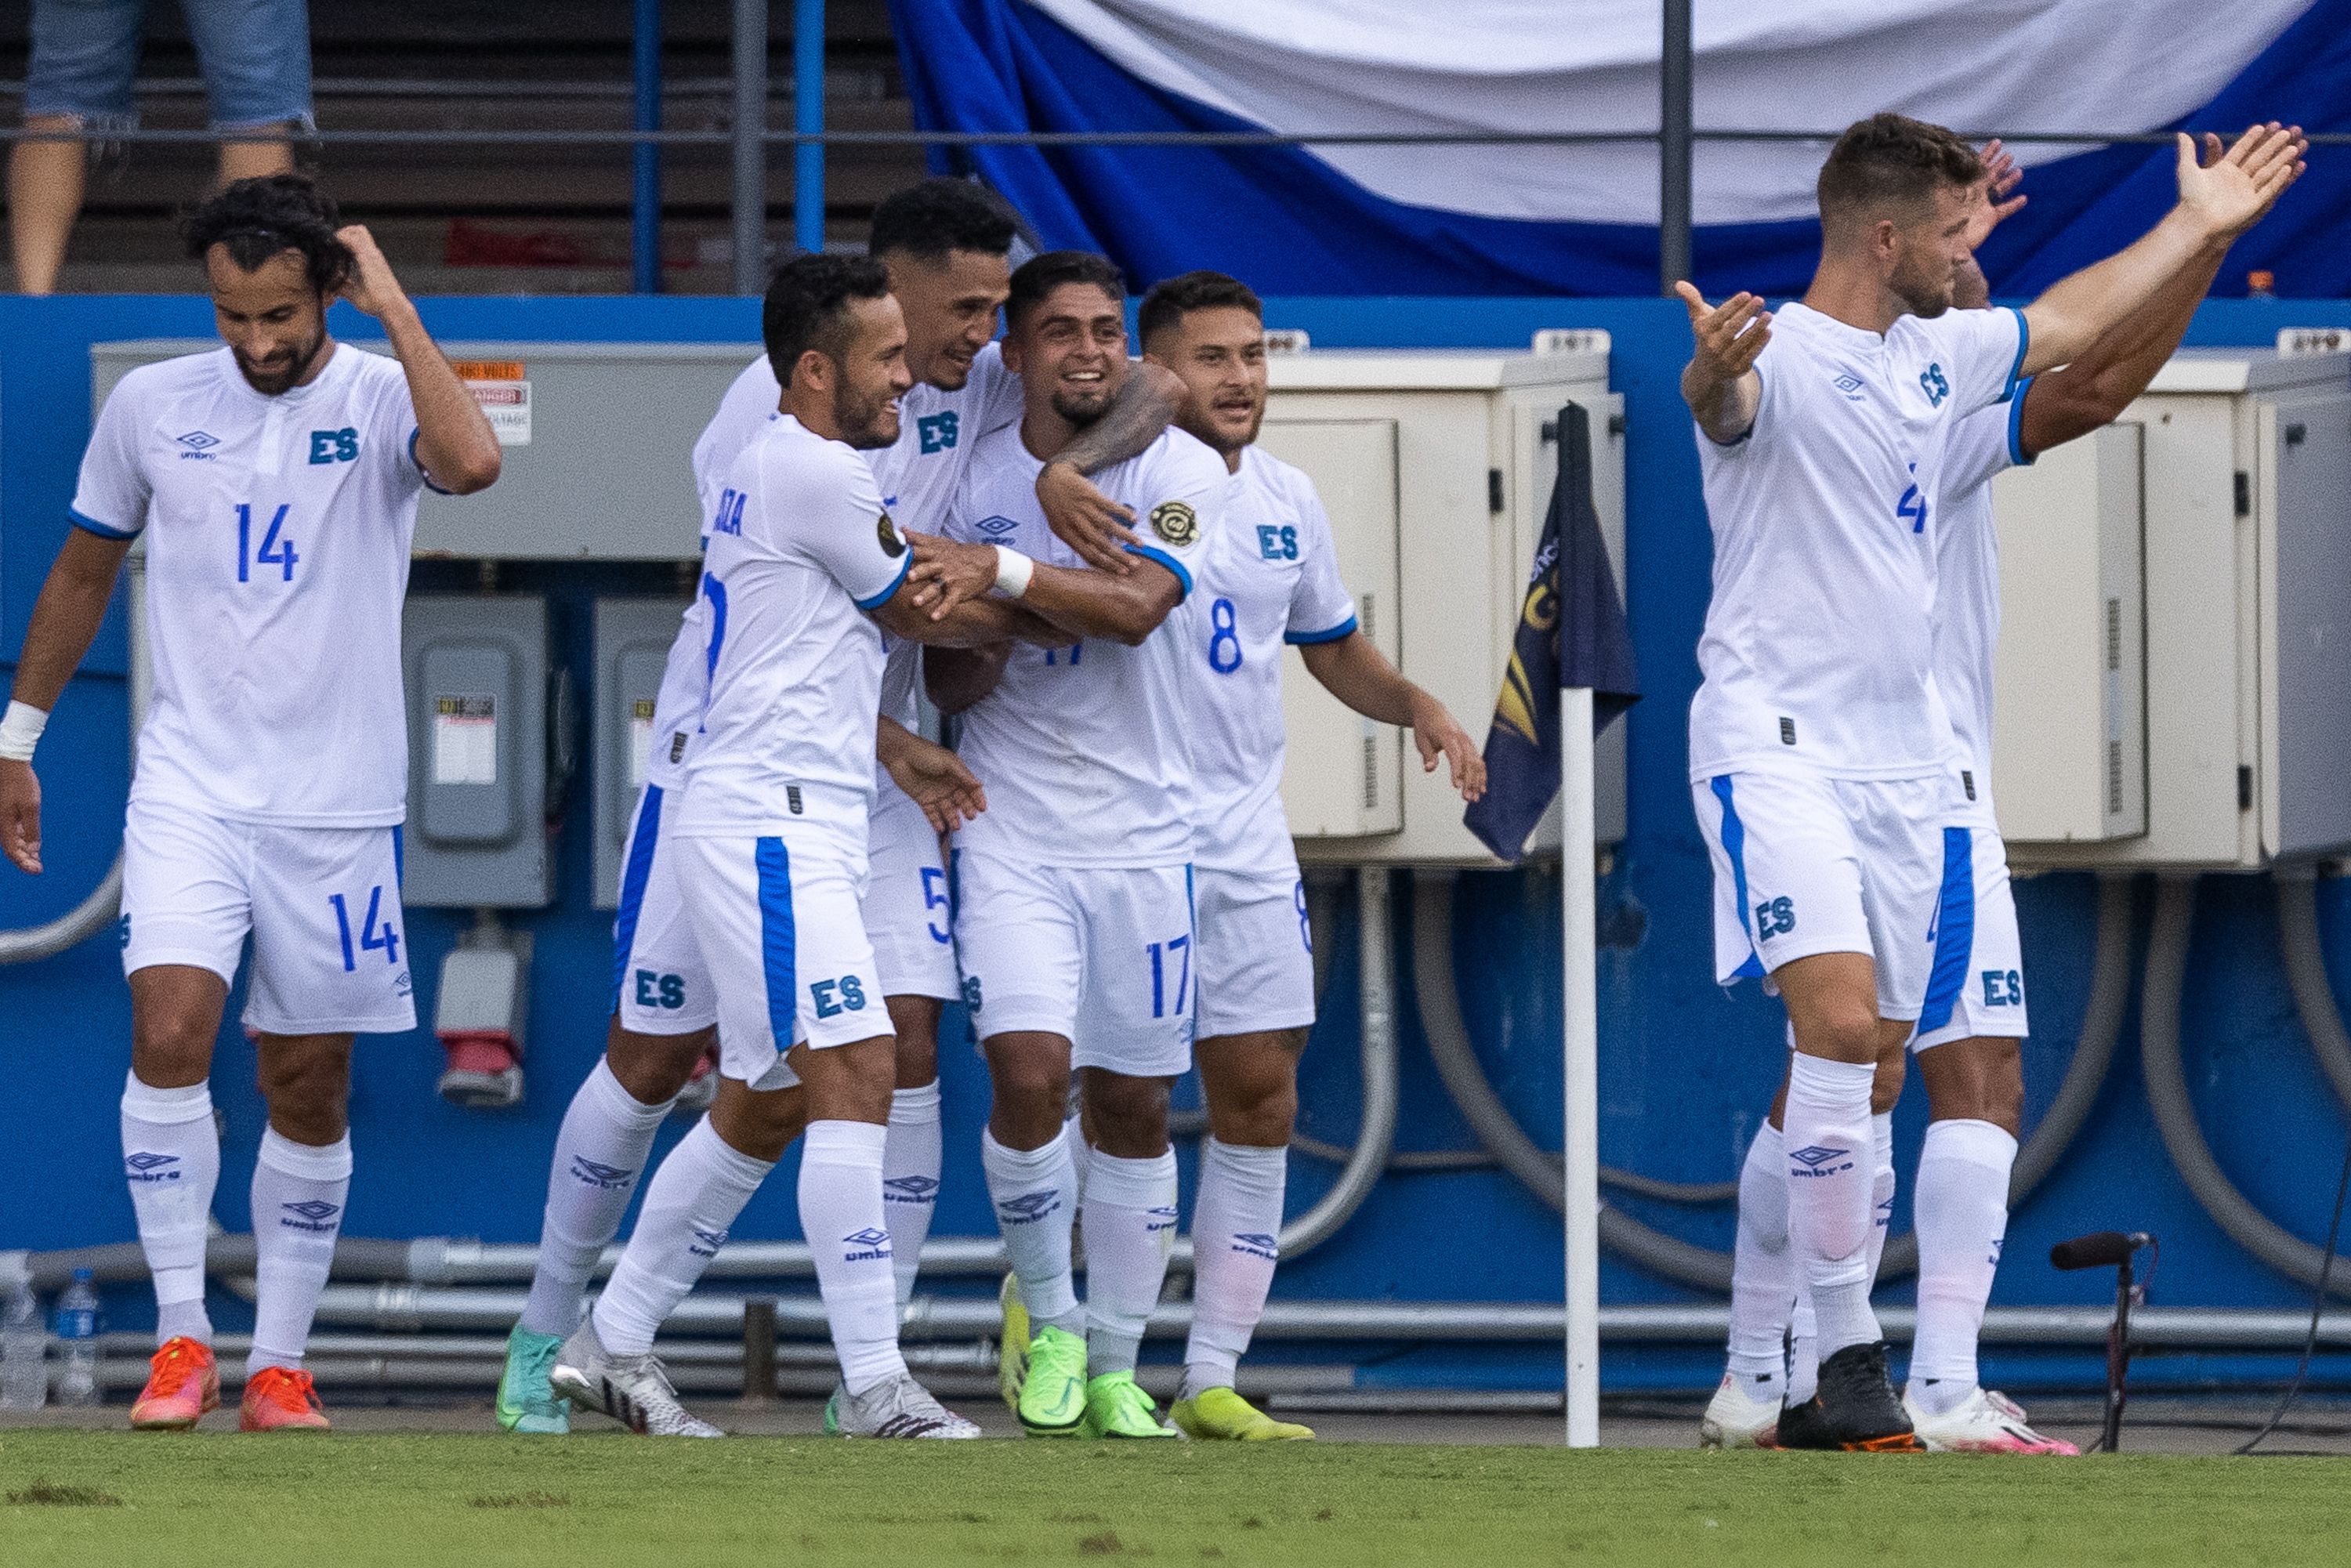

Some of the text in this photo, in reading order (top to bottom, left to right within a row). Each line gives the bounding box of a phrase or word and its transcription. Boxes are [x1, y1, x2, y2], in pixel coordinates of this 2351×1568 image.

[475, 389, 516, 404] ANGER
[310, 428, 359, 465] ES
[917, 411, 958, 454] ES
[180, 451, 217, 461] umbro
[1896, 463, 1927, 534] 4
[235, 503, 299, 582] 14
[1256, 524, 1298, 560] ES
[1209, 598, 1243, 674] 8
[920, 867, 950, 943] 5
[1755, 896, 1795, 942] ES
[328, 885, 400, 972] 14
[636, 969, 686, 1009] ES
[810, 975, 866, 1019] ES
[1146, 933, 1190, 1018] 17
[1982, 969, 2022, 1006] ES
[1791, 1161, 1854, 1177] umbro
